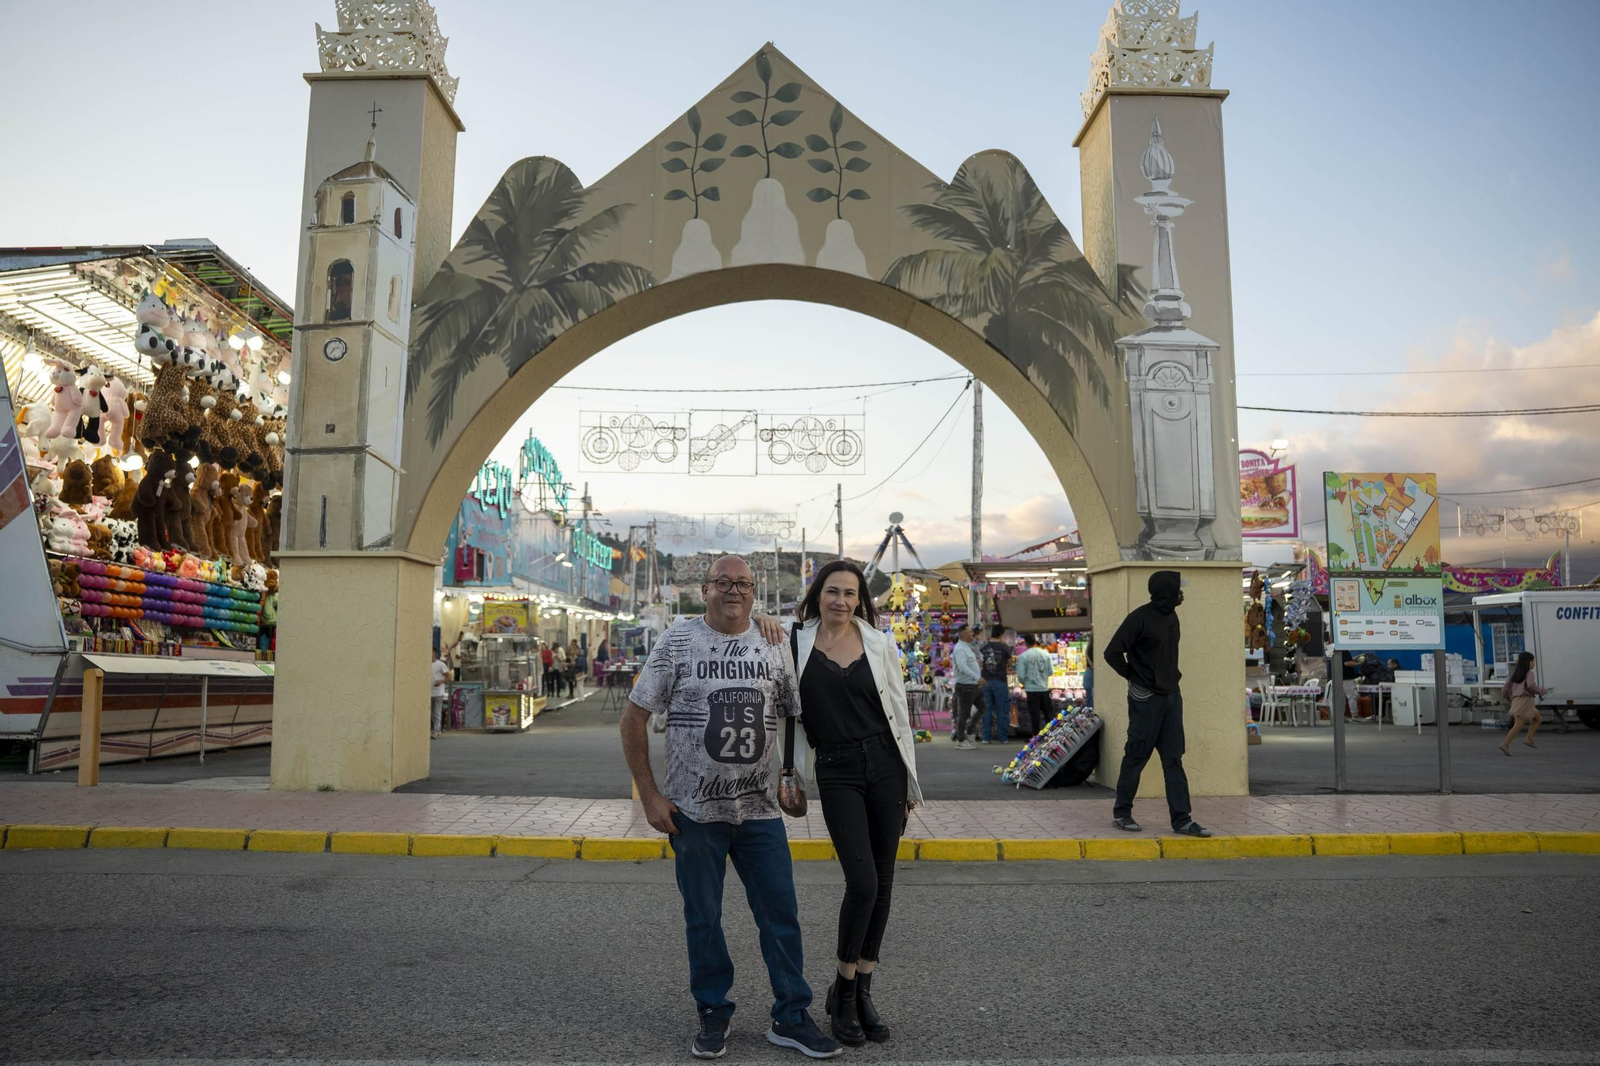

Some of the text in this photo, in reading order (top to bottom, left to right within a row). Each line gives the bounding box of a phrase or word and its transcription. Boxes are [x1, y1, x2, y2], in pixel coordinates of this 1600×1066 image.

[1241, 459, 1266, 468] BONITA
[1405, 594, 1437, 605] albox
[1556, 606, 1600, 620] CONFIT
[721, 639, 750, 657] The
[696, 660, 773, 681] ORIGINAL
[712, 691, 763, 705] CALIFORNIA
[719, 726, 758, 758] 23
[692, 769, 770, 799] Adventure
